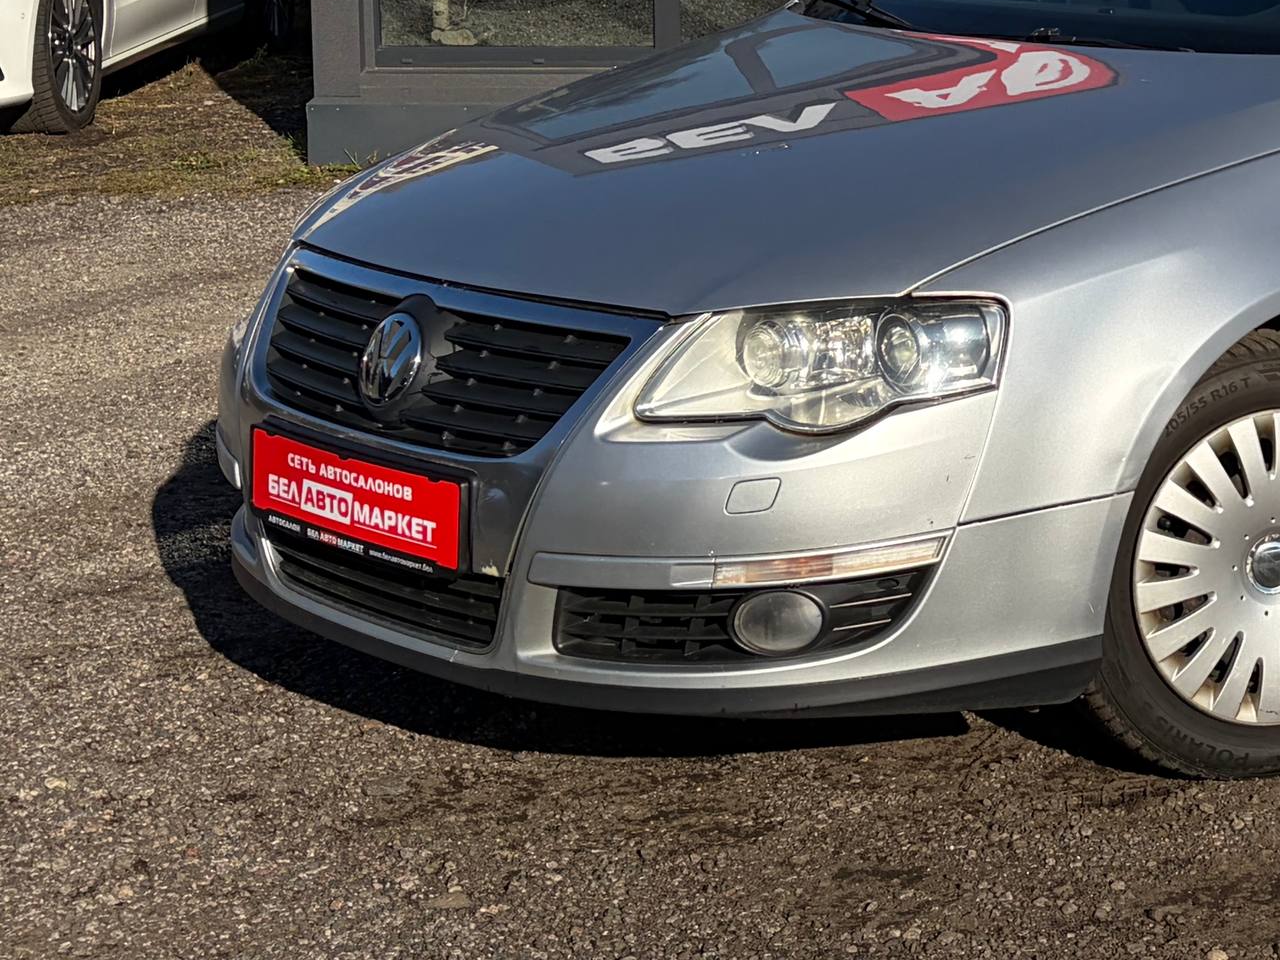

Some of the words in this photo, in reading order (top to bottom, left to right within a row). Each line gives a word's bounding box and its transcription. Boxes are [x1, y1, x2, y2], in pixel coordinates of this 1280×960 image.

[1165, 396, 1208, 437] 205/55
[1210, 381, 1239, 401] R16
[1239, 376, 1250, 389] T
[287, 452, 317, 475] СЕТЬ
[319, 463, 413, 501] АВТОСАЛОНОВ
[268, 473, 300, 503] БЕЛ
[303, 484, 351, 519] АВТО
[353, 501, 437, 543] МАРКЕТ
[268, 514, 301, 533] АВТОСАЛОН
[320, 532, 337, 546] АВТО
[337, 537, 364, 555] МАРКЕТ
